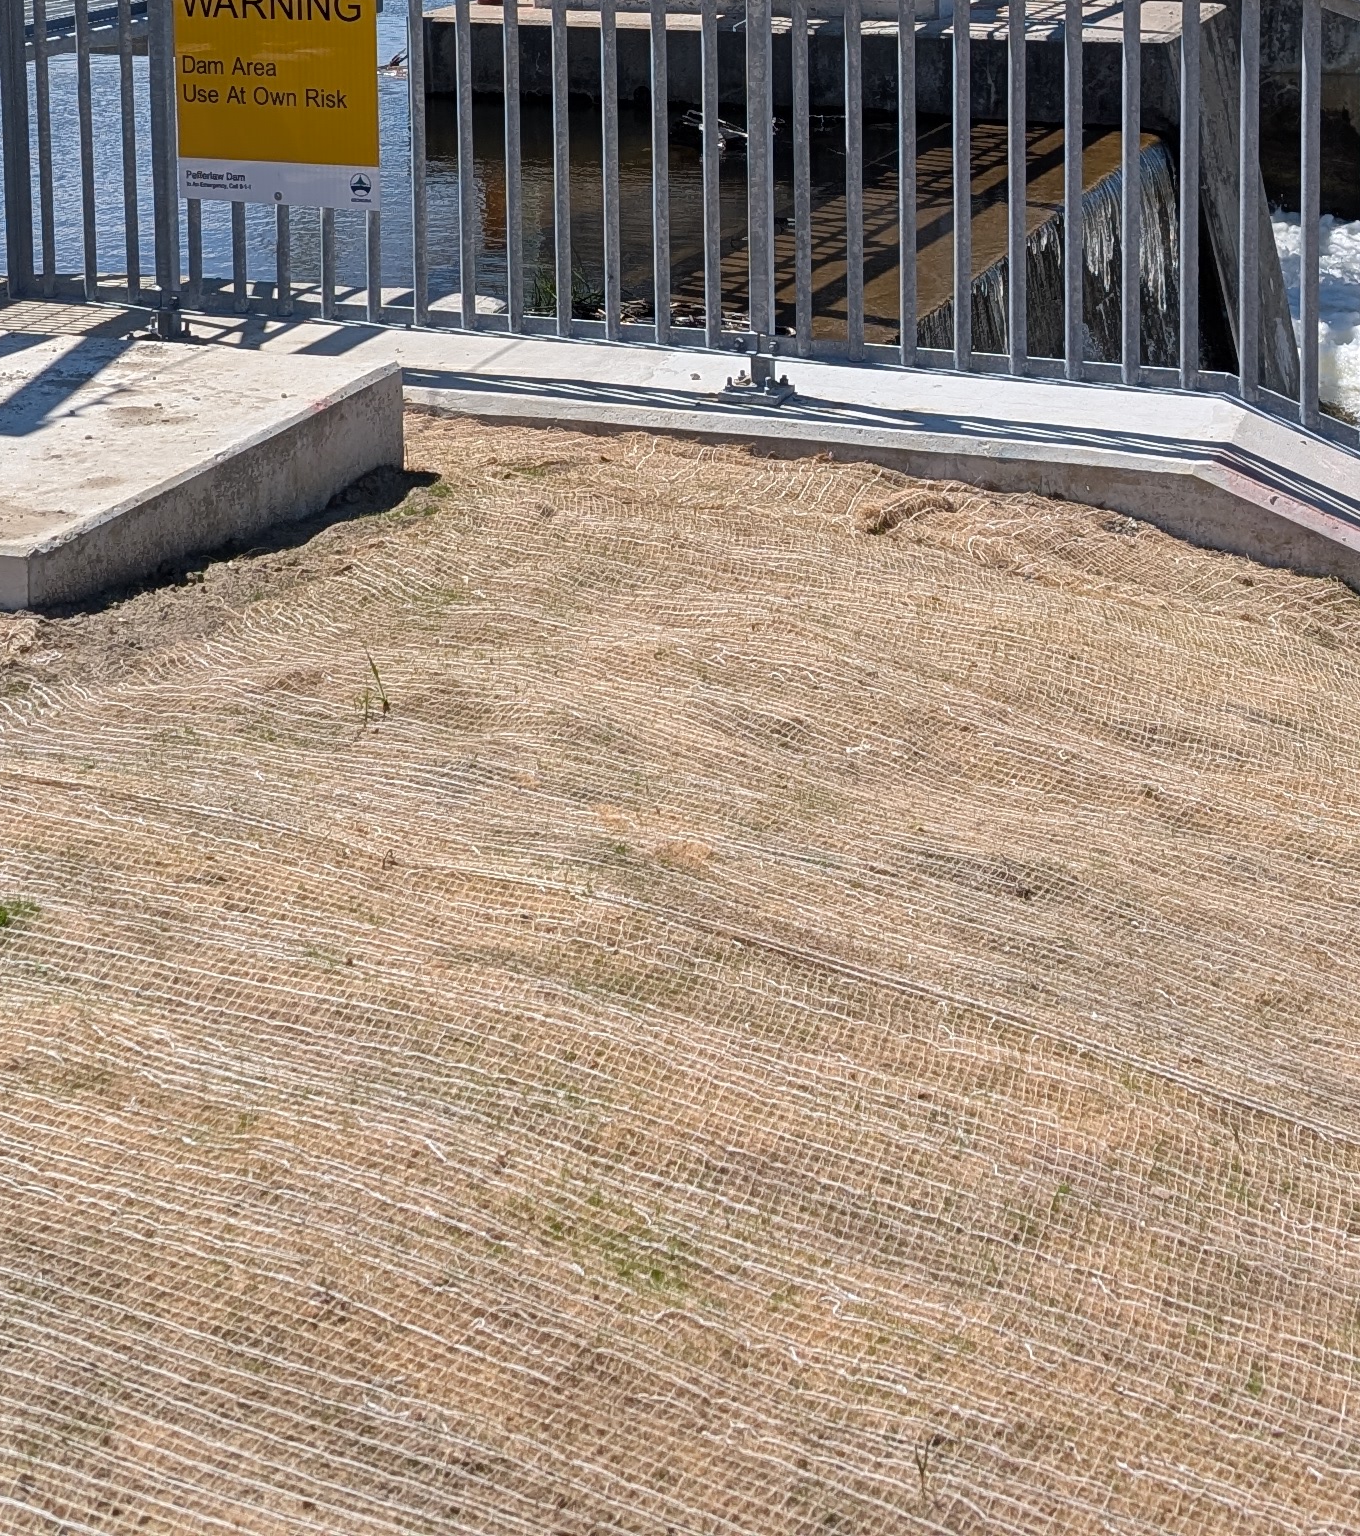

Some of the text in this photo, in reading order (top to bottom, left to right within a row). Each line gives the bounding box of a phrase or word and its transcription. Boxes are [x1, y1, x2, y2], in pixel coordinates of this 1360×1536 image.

[182, 55, 277, 77] Dam Area
[182, 84, 348, 109] Use At Own Risk
[226, 172, 245, 181] Dam
